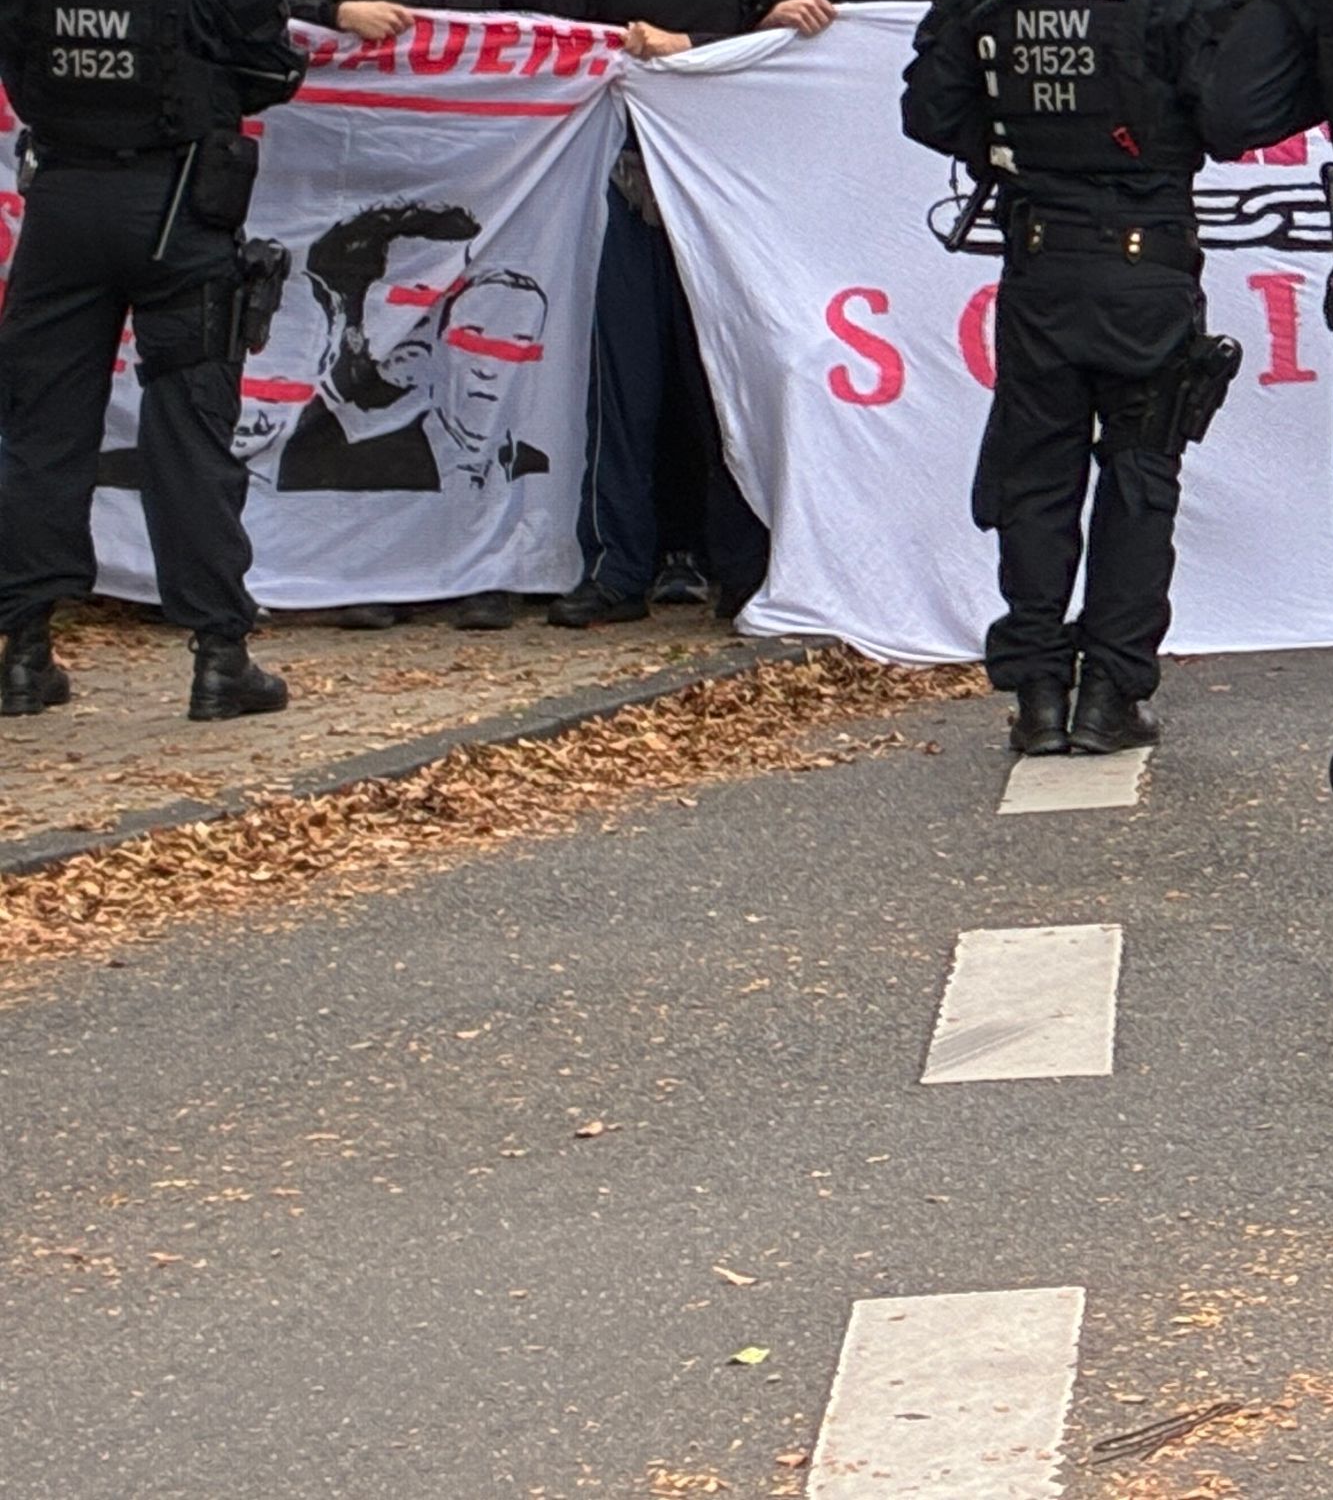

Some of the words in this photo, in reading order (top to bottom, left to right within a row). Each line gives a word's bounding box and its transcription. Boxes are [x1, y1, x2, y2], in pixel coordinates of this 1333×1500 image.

[56, 8, 130, 39] NRW
[1016, 9, 1090, 39] NRW
[52, 48, 135, 79] 31523
[1013, 46, 1096, 75] 31523
[1033, 82, 1077, 111] RH
